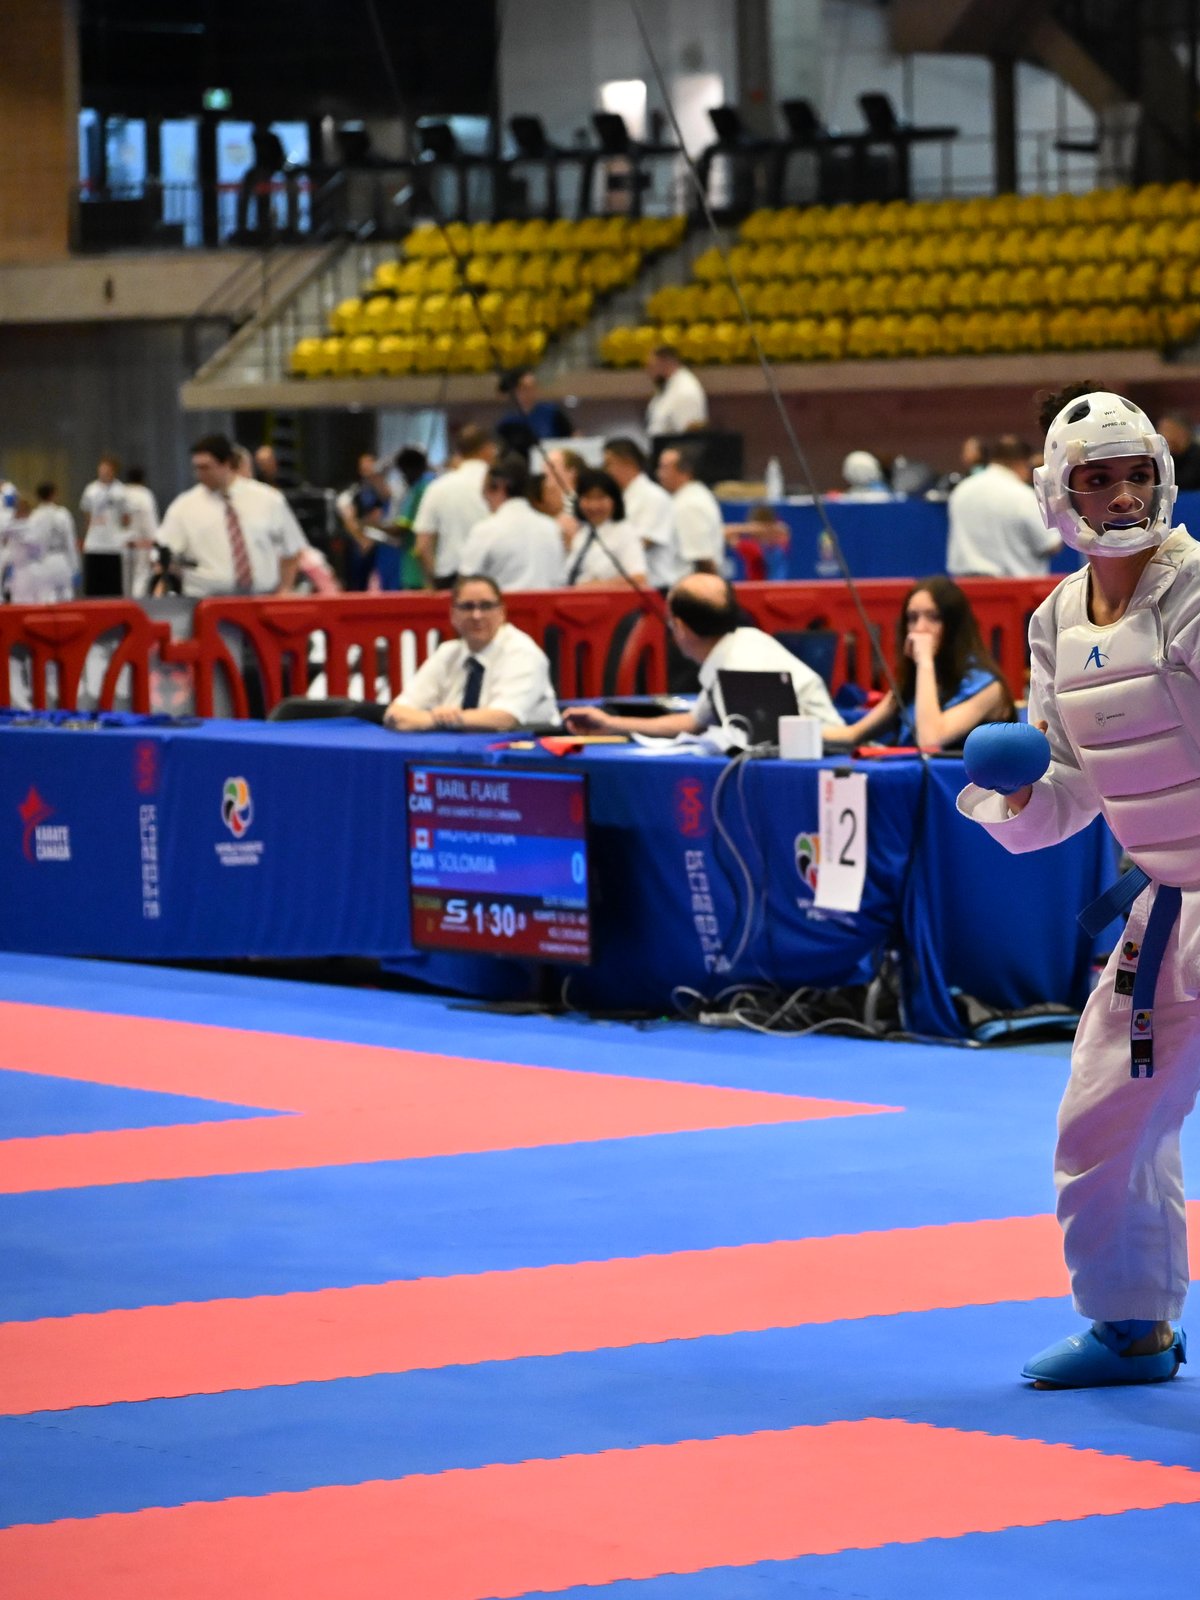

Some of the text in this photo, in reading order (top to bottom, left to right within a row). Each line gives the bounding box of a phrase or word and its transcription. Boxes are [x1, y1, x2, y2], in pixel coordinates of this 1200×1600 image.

[408, 794, 434, 813] CAN
[839, 807, 857, 867] 2
[410, 851, 435, 871] CAN
[571, 851, 586, 885] 0
